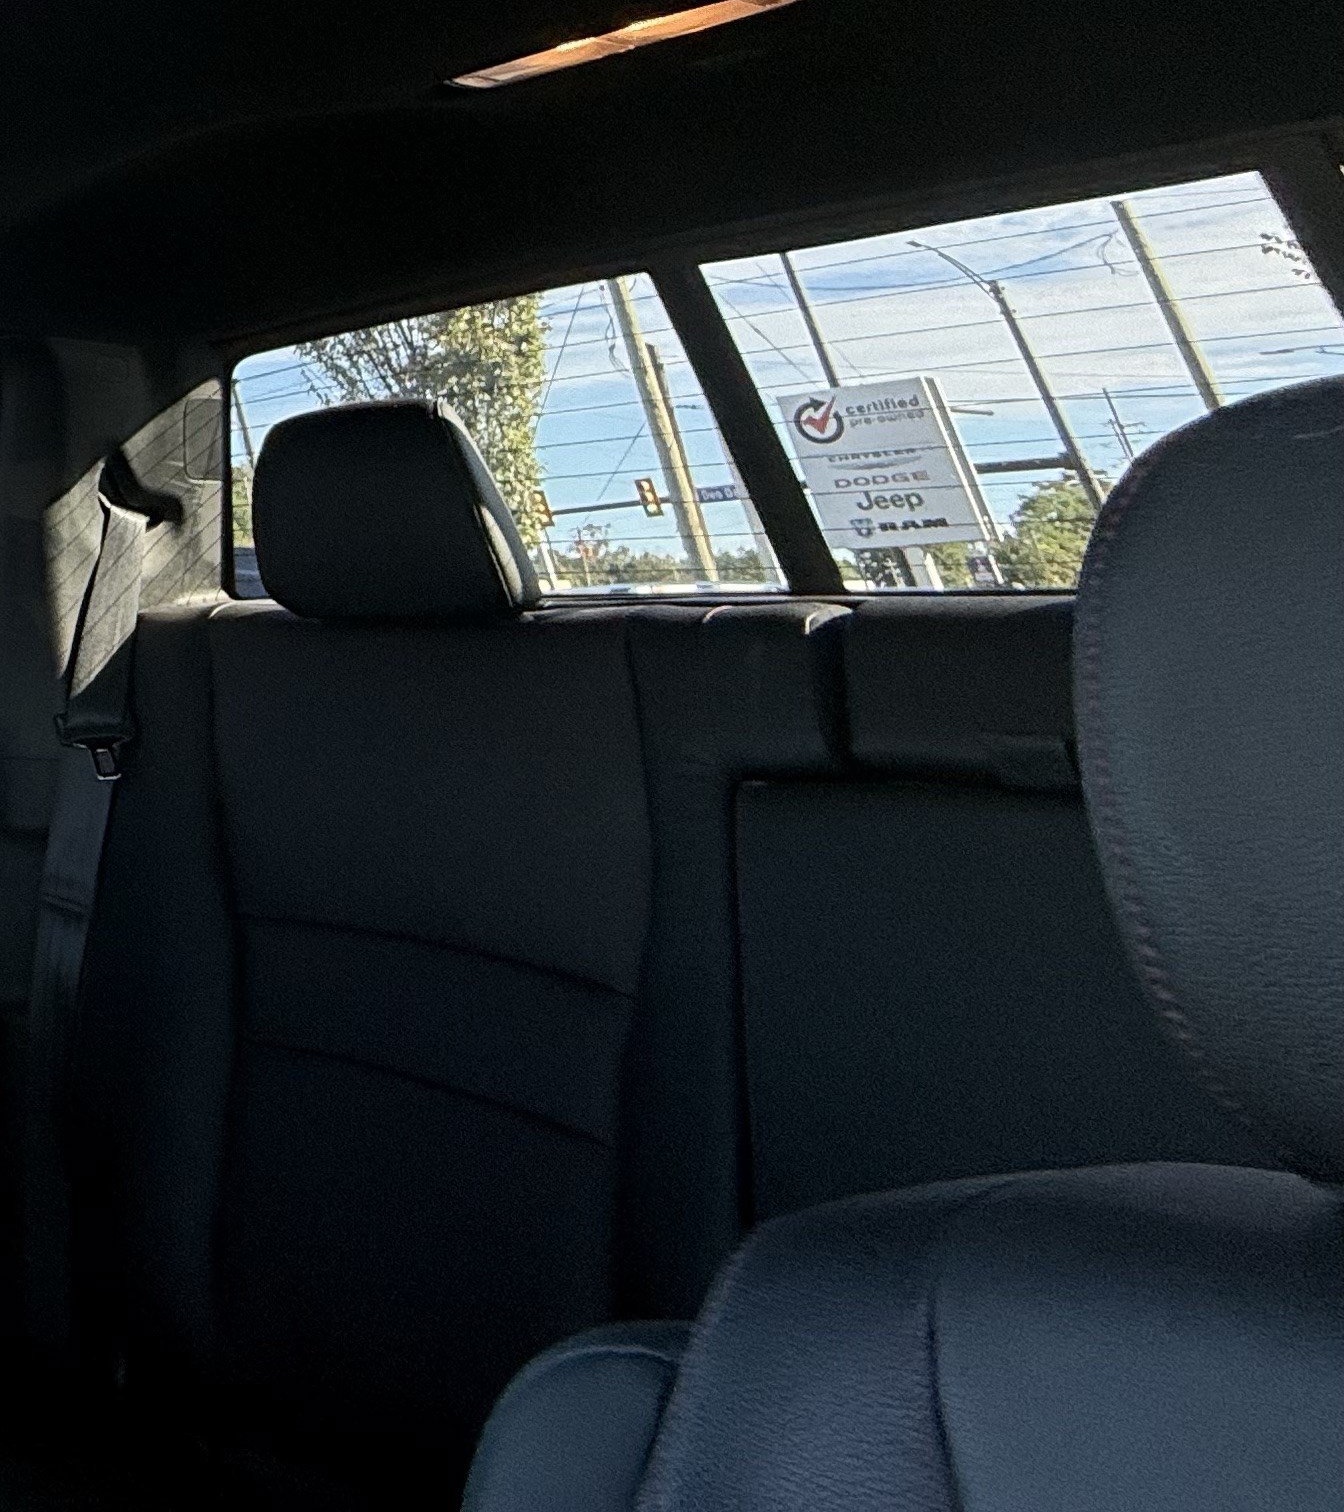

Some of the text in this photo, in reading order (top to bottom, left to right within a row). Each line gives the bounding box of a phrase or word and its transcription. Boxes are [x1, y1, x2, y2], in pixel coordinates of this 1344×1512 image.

[845, 394, 920, 415] certified
[849, 410, 924, 427] pre-owned
[834, 471, 931, 488] DODGE
[856, 491, 924, 511] Jeep
[878, 517, 949, 532] RAM
